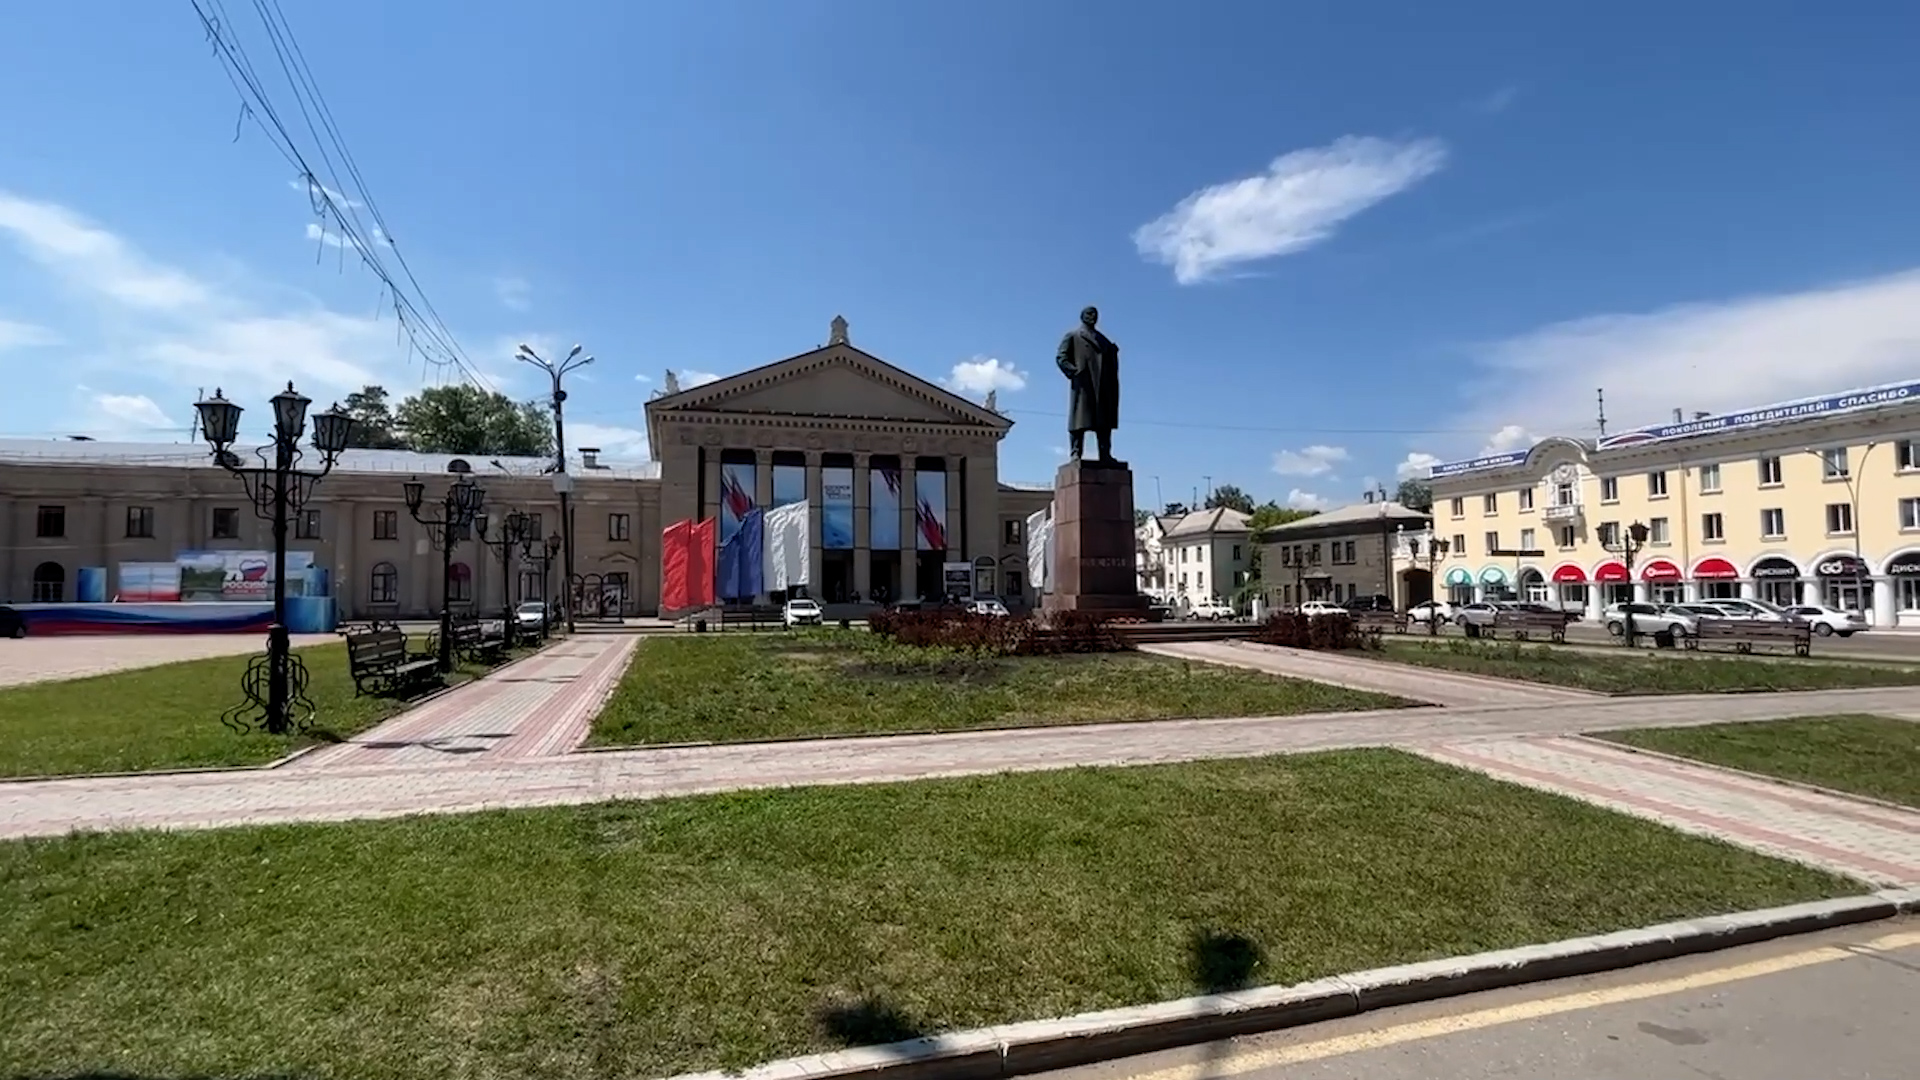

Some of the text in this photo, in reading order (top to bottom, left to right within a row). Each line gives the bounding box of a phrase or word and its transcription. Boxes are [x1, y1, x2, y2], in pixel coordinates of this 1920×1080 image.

[1661, 388, 1909, 437] ПОКОЛЕНИЕ ПОБЕДИТЕЛЕЙ! СПАСИБО
